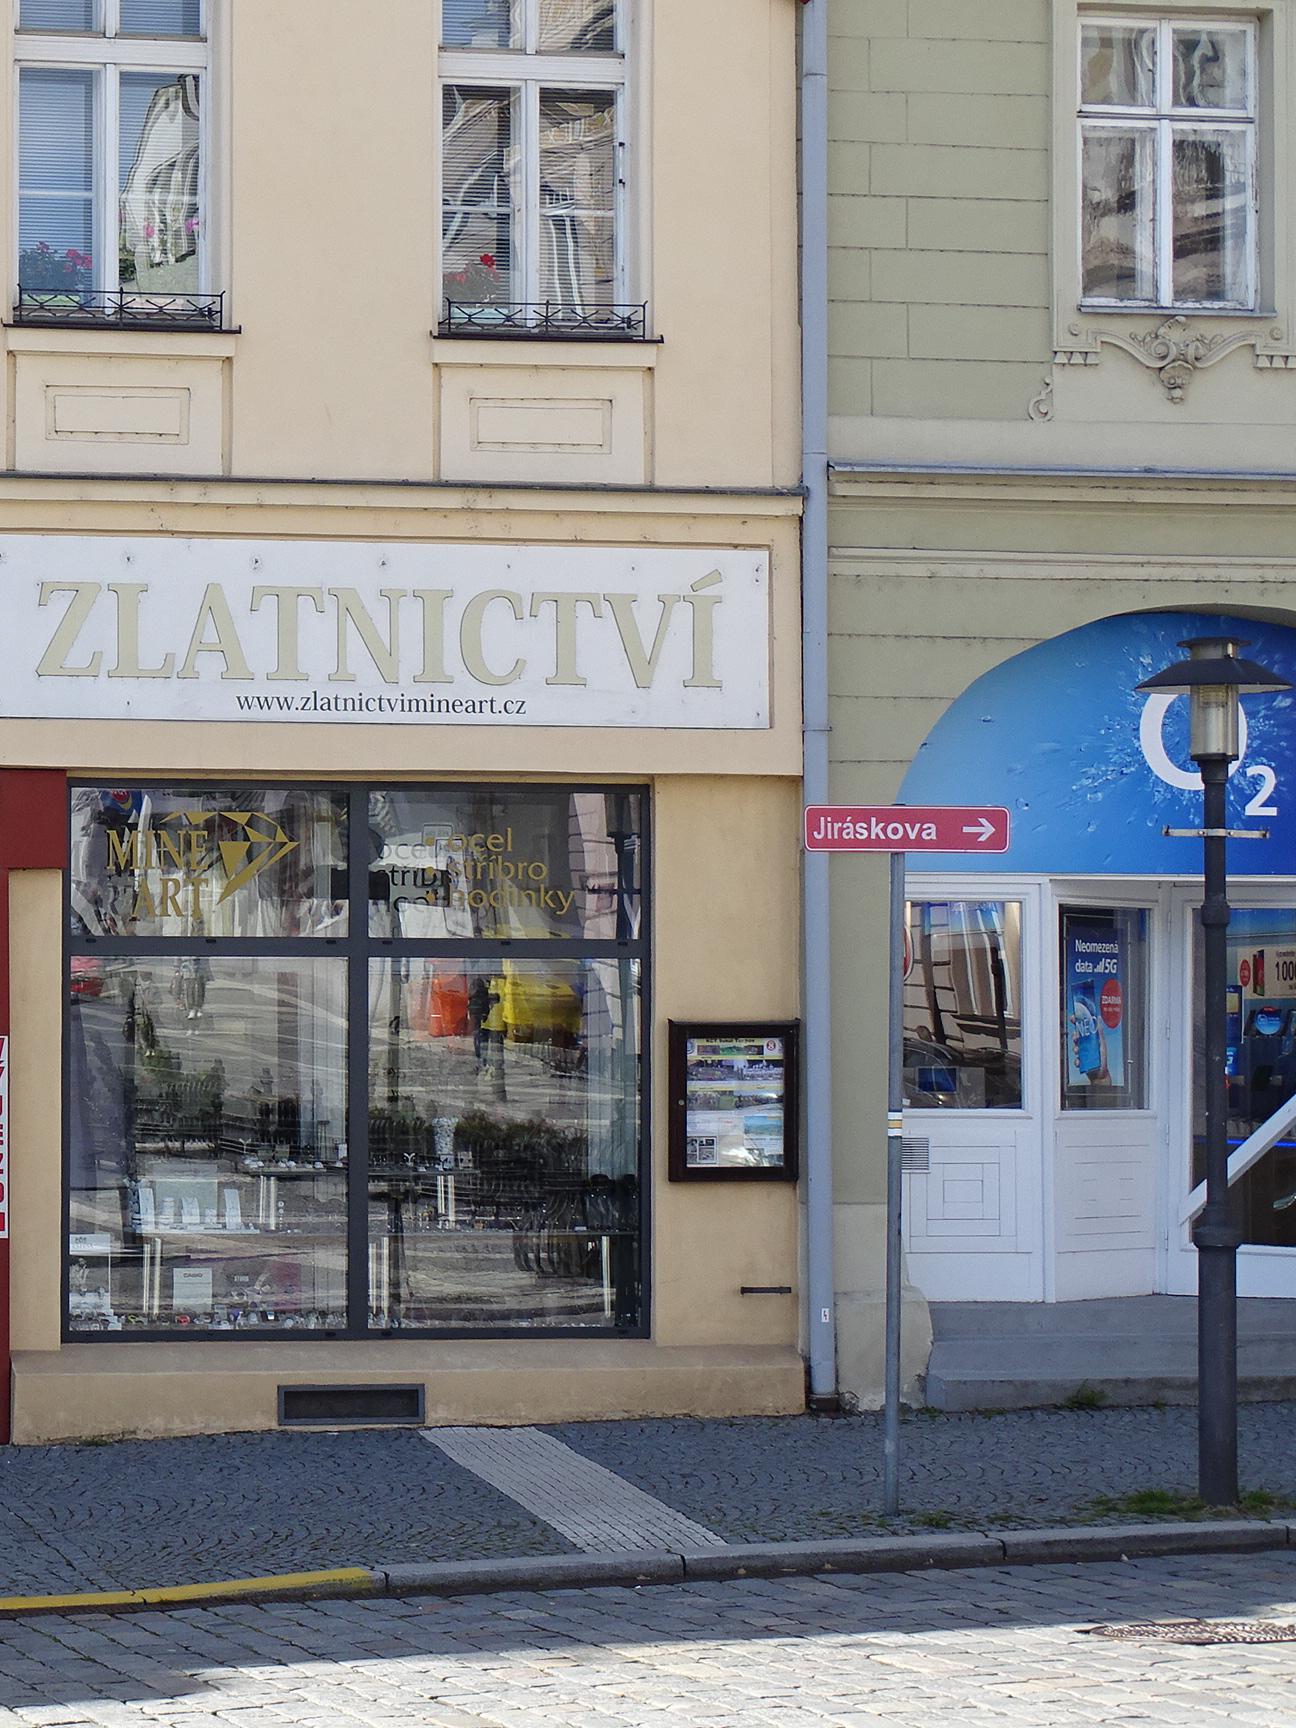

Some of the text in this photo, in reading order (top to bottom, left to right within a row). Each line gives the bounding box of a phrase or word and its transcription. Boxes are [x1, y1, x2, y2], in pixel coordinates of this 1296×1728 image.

[35, 567, 725, 690] ZLATNICTVÍ
[235, 691, 528, 717] www.zlatnictvimineart.cz
[448, 827, 513, 852] ocel
[813, 817, 937, 840] Jiráskova
[106, 830, 209, 871] MINE
[131, 877, 209, 920] ART
[1075, 959, 1093, 973] data
